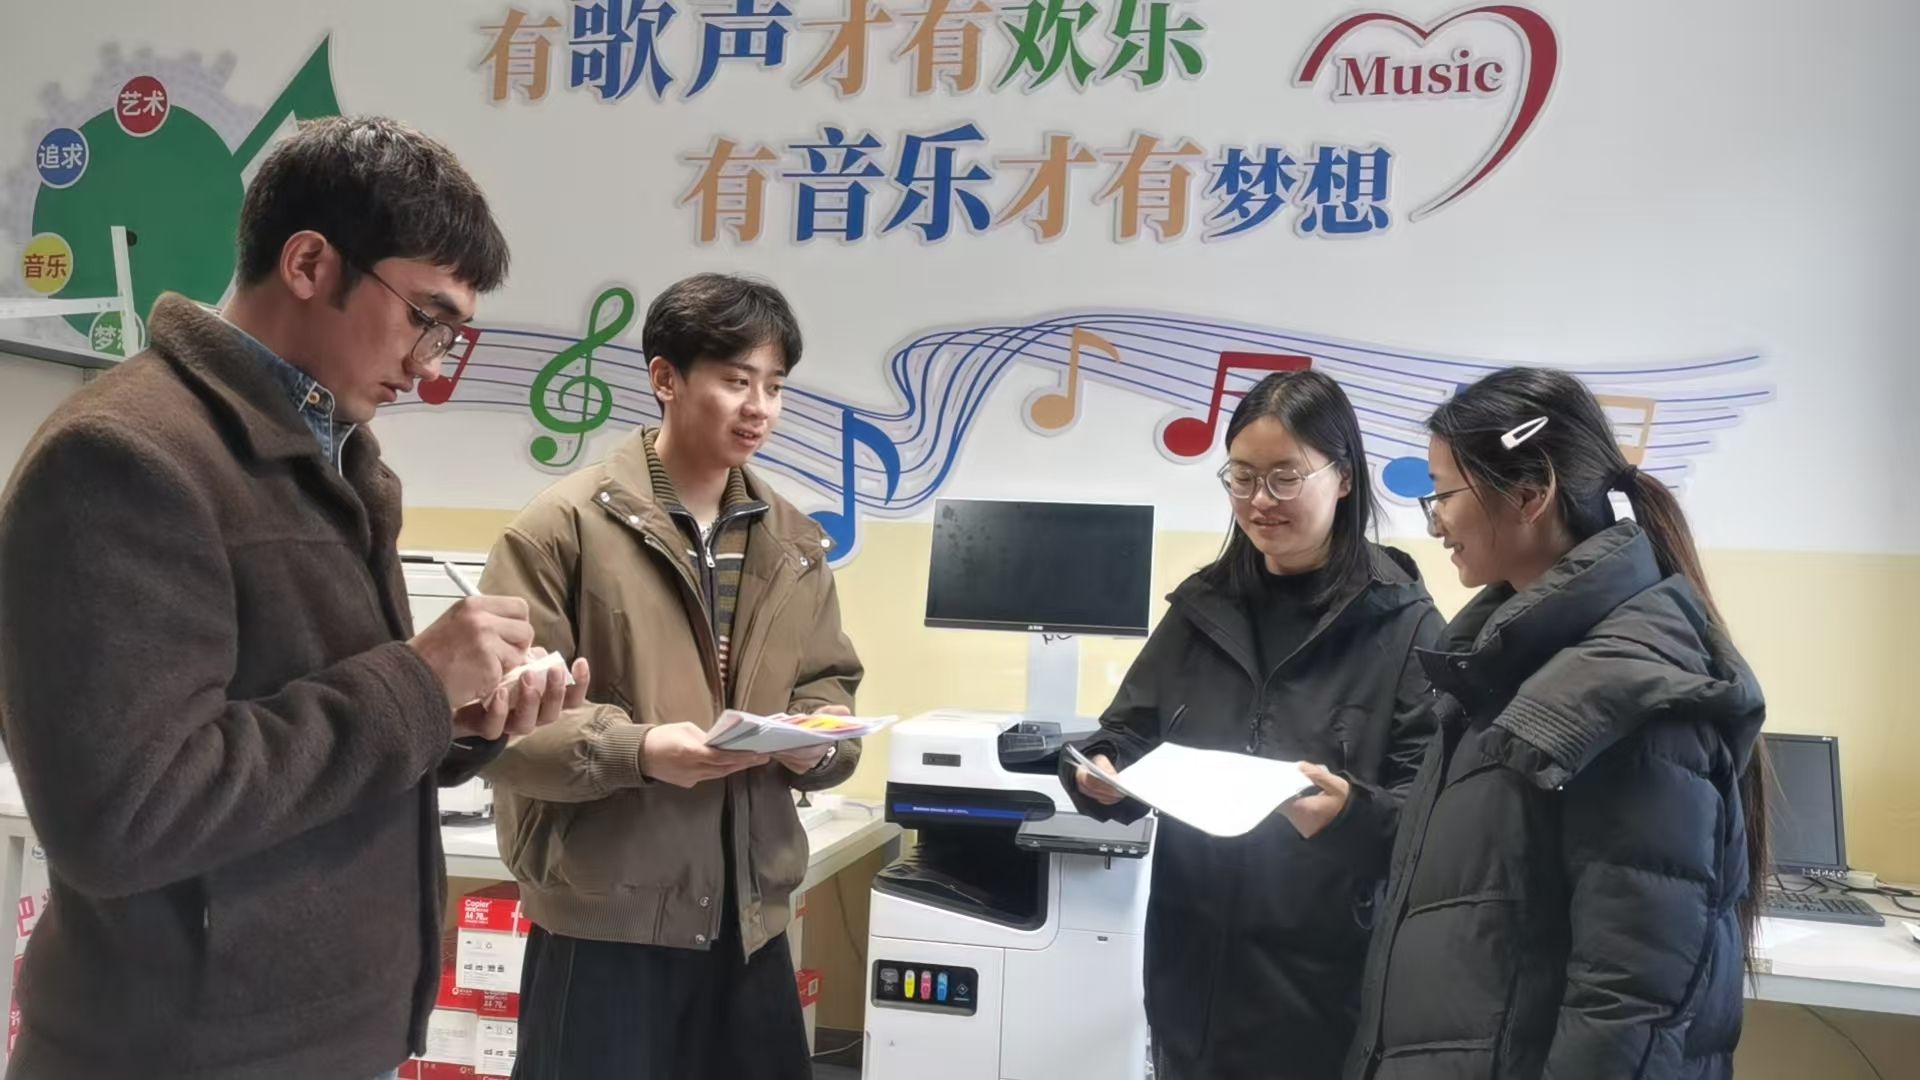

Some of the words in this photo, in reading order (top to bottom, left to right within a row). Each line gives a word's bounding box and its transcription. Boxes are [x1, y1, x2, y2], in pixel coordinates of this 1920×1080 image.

[479, 0, 1204, 101] 有歌声才有欢乐
[1340, 49, 1503, 97] Music
[120, 90, 165, 117] 艺术
[38, 142, 84, 169] 追求
[680, 123, 1392, 243] 有音乐才有梦想
[23, 253, 67, 279] 音乐
